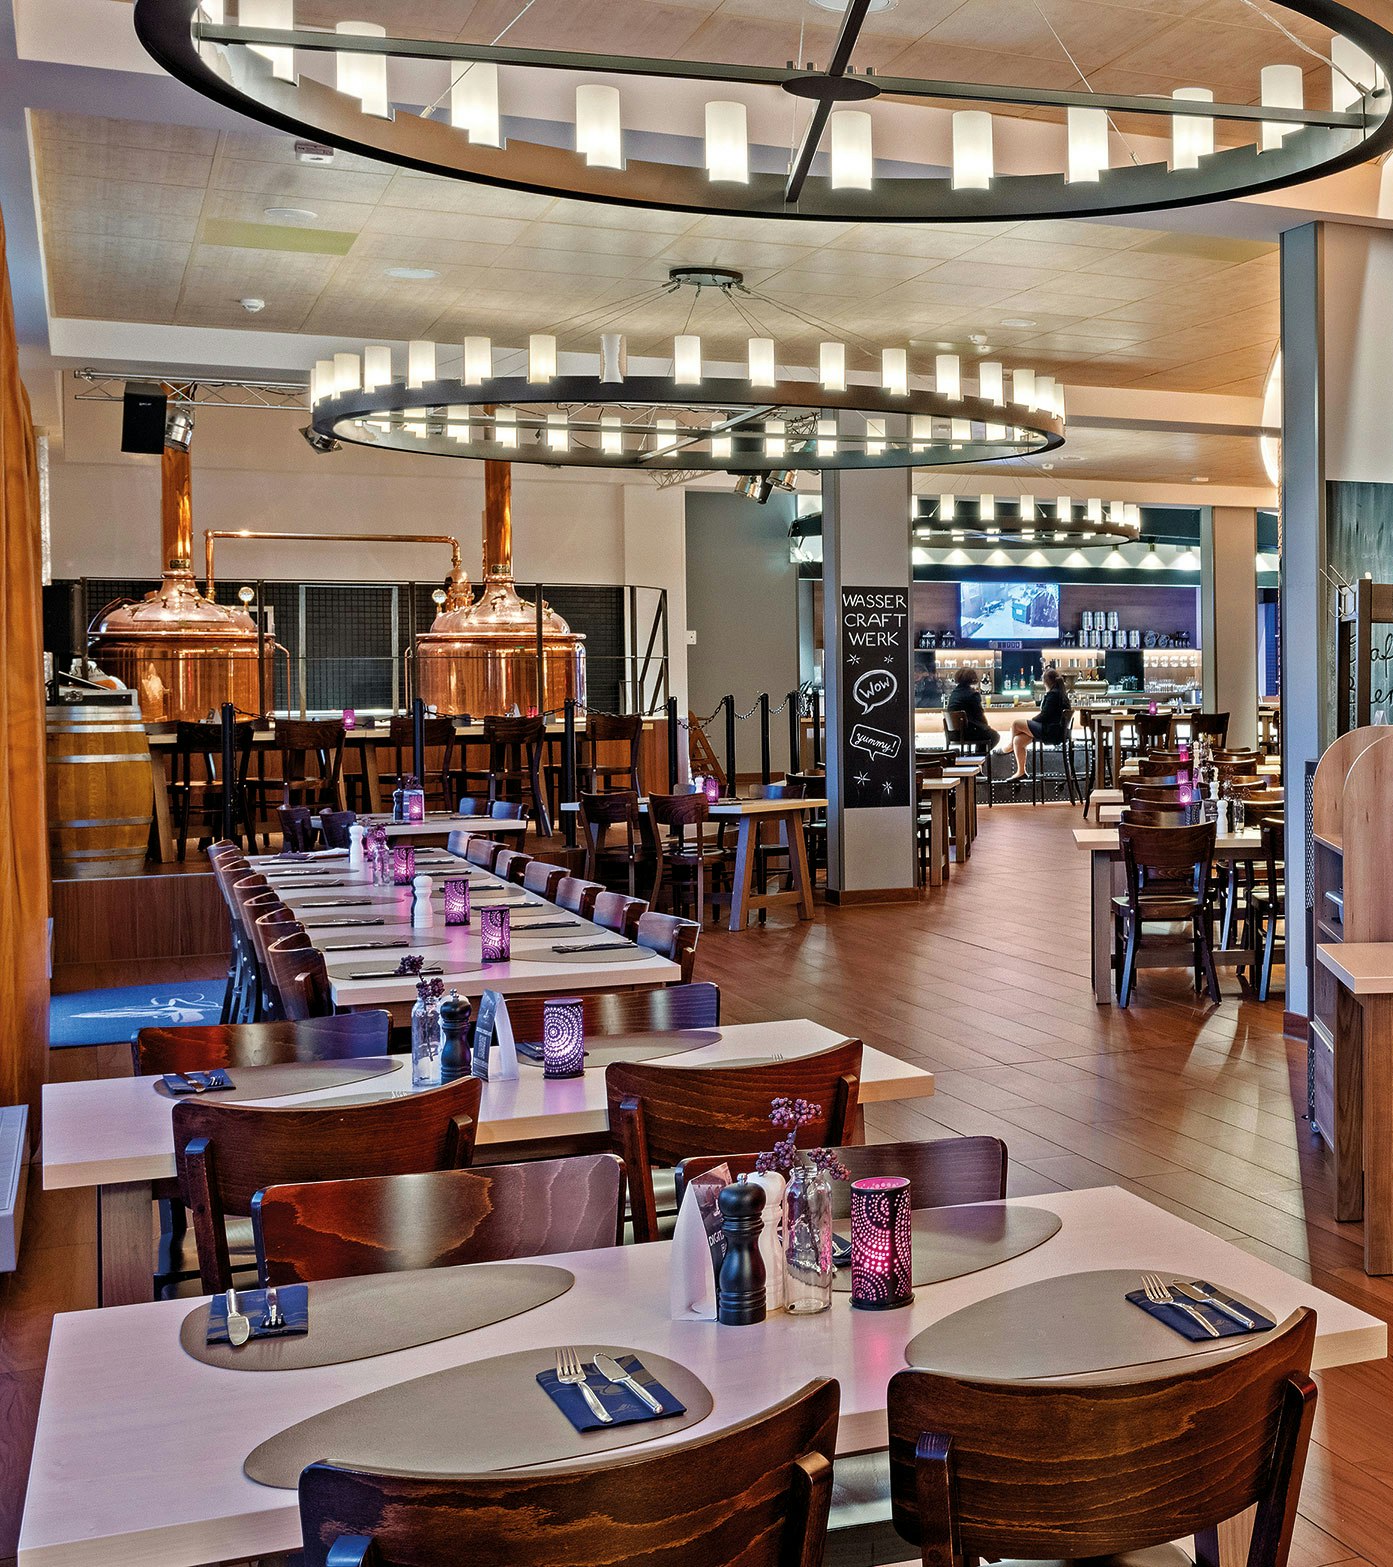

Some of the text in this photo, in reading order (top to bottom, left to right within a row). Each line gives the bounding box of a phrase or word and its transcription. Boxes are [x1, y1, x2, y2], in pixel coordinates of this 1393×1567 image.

[842, 593, 907, 609] WASSER
[844, 613, 907, 628] CRAFT
[848, 632, 899, 647] WERK
[855, 731, 897, 752] yummy!
